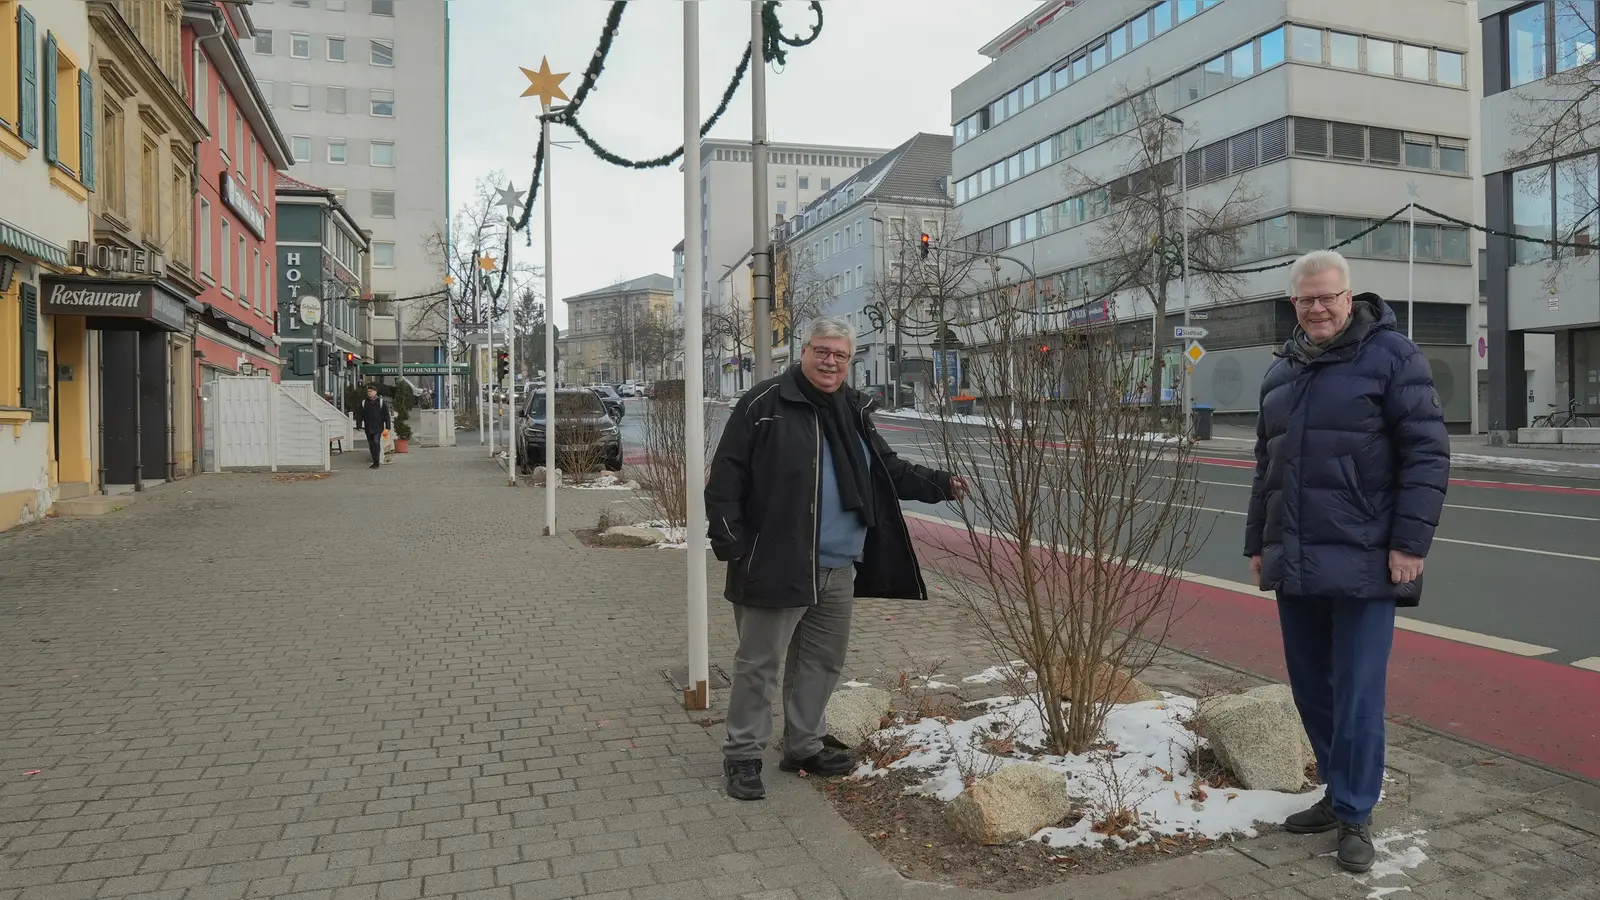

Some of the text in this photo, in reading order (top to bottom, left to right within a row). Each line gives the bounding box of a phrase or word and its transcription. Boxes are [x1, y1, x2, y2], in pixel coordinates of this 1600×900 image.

[69, 240, 166, 277] HOTEL
[50, 284, 142, 307] Restaurant
[286, 252, 301, 330] HOTEL
